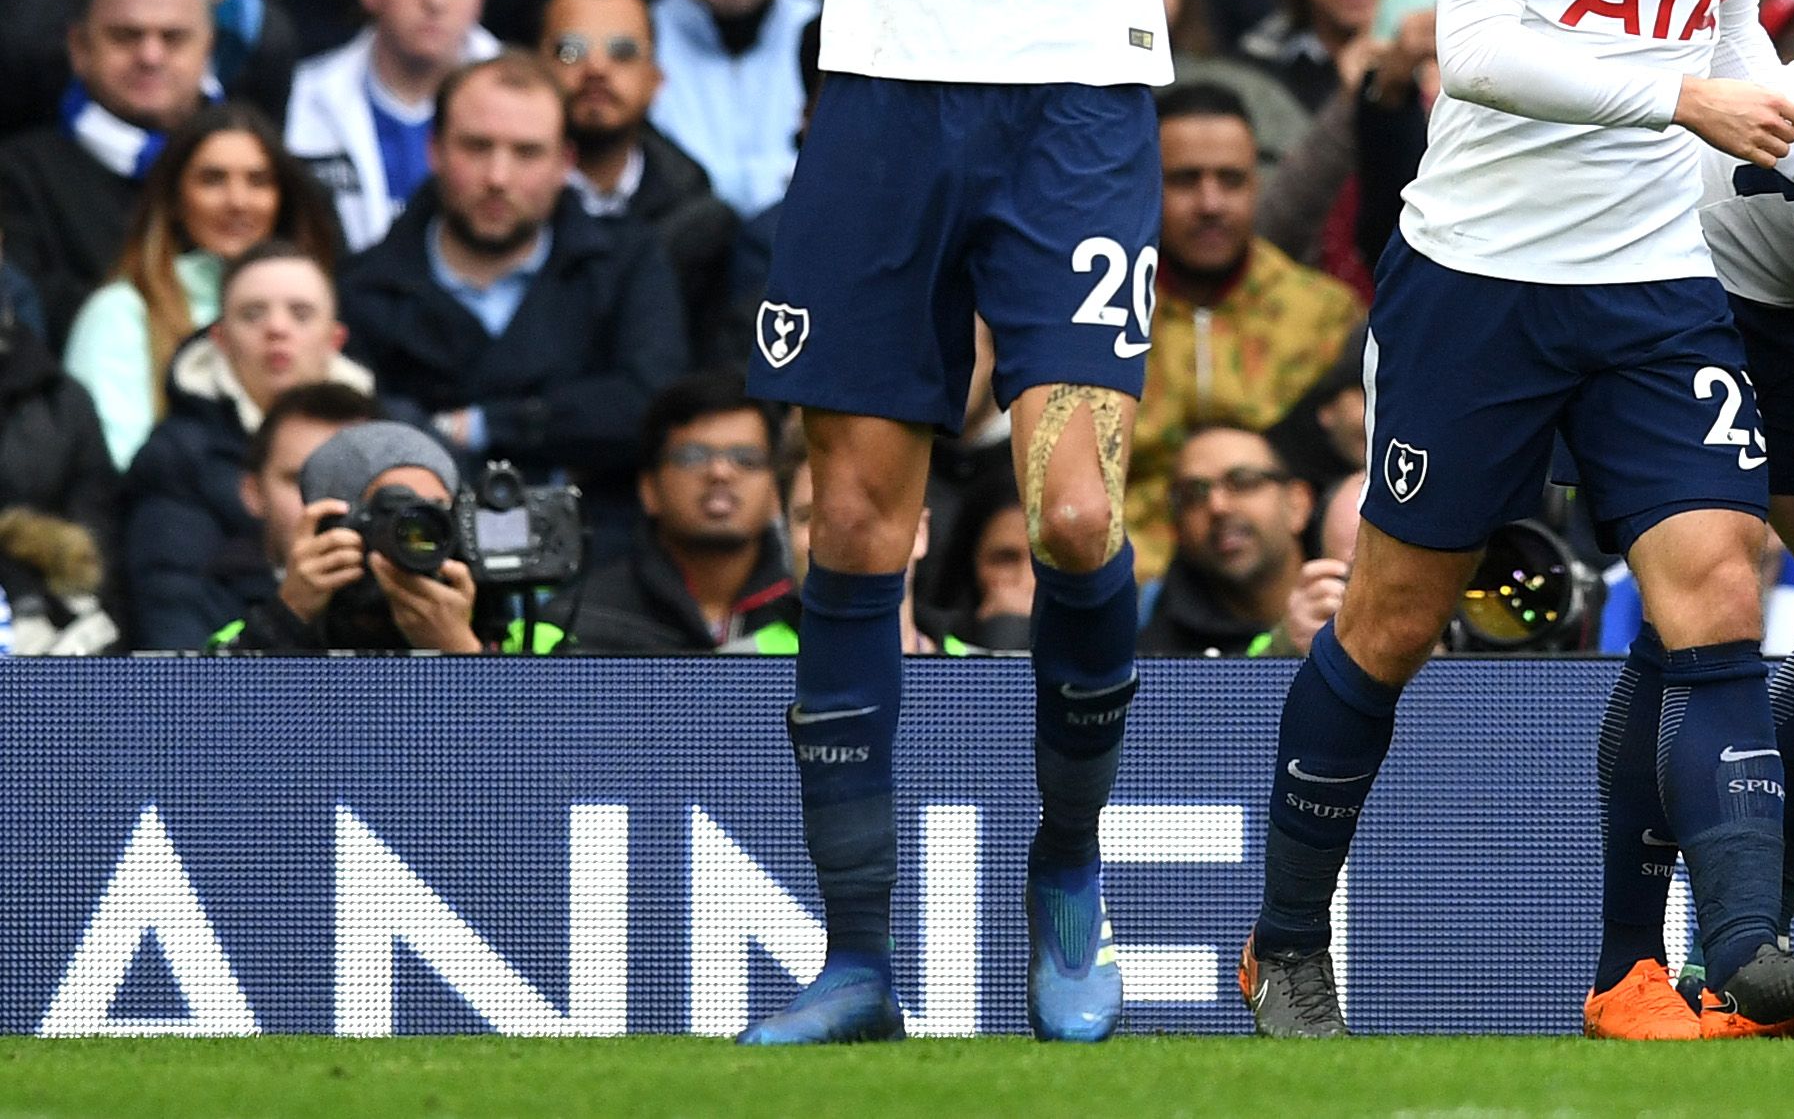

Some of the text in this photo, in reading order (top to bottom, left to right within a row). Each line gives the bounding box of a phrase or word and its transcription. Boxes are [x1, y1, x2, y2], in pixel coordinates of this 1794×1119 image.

[1071, 236, 1158, 338] 20
[1693, 367, 1766, 453] 2
[799, 745, 870, 764] SPURS
[1285, 793, 1359, 819] SPURS
[1641, 862, 1676, 878] SPU
